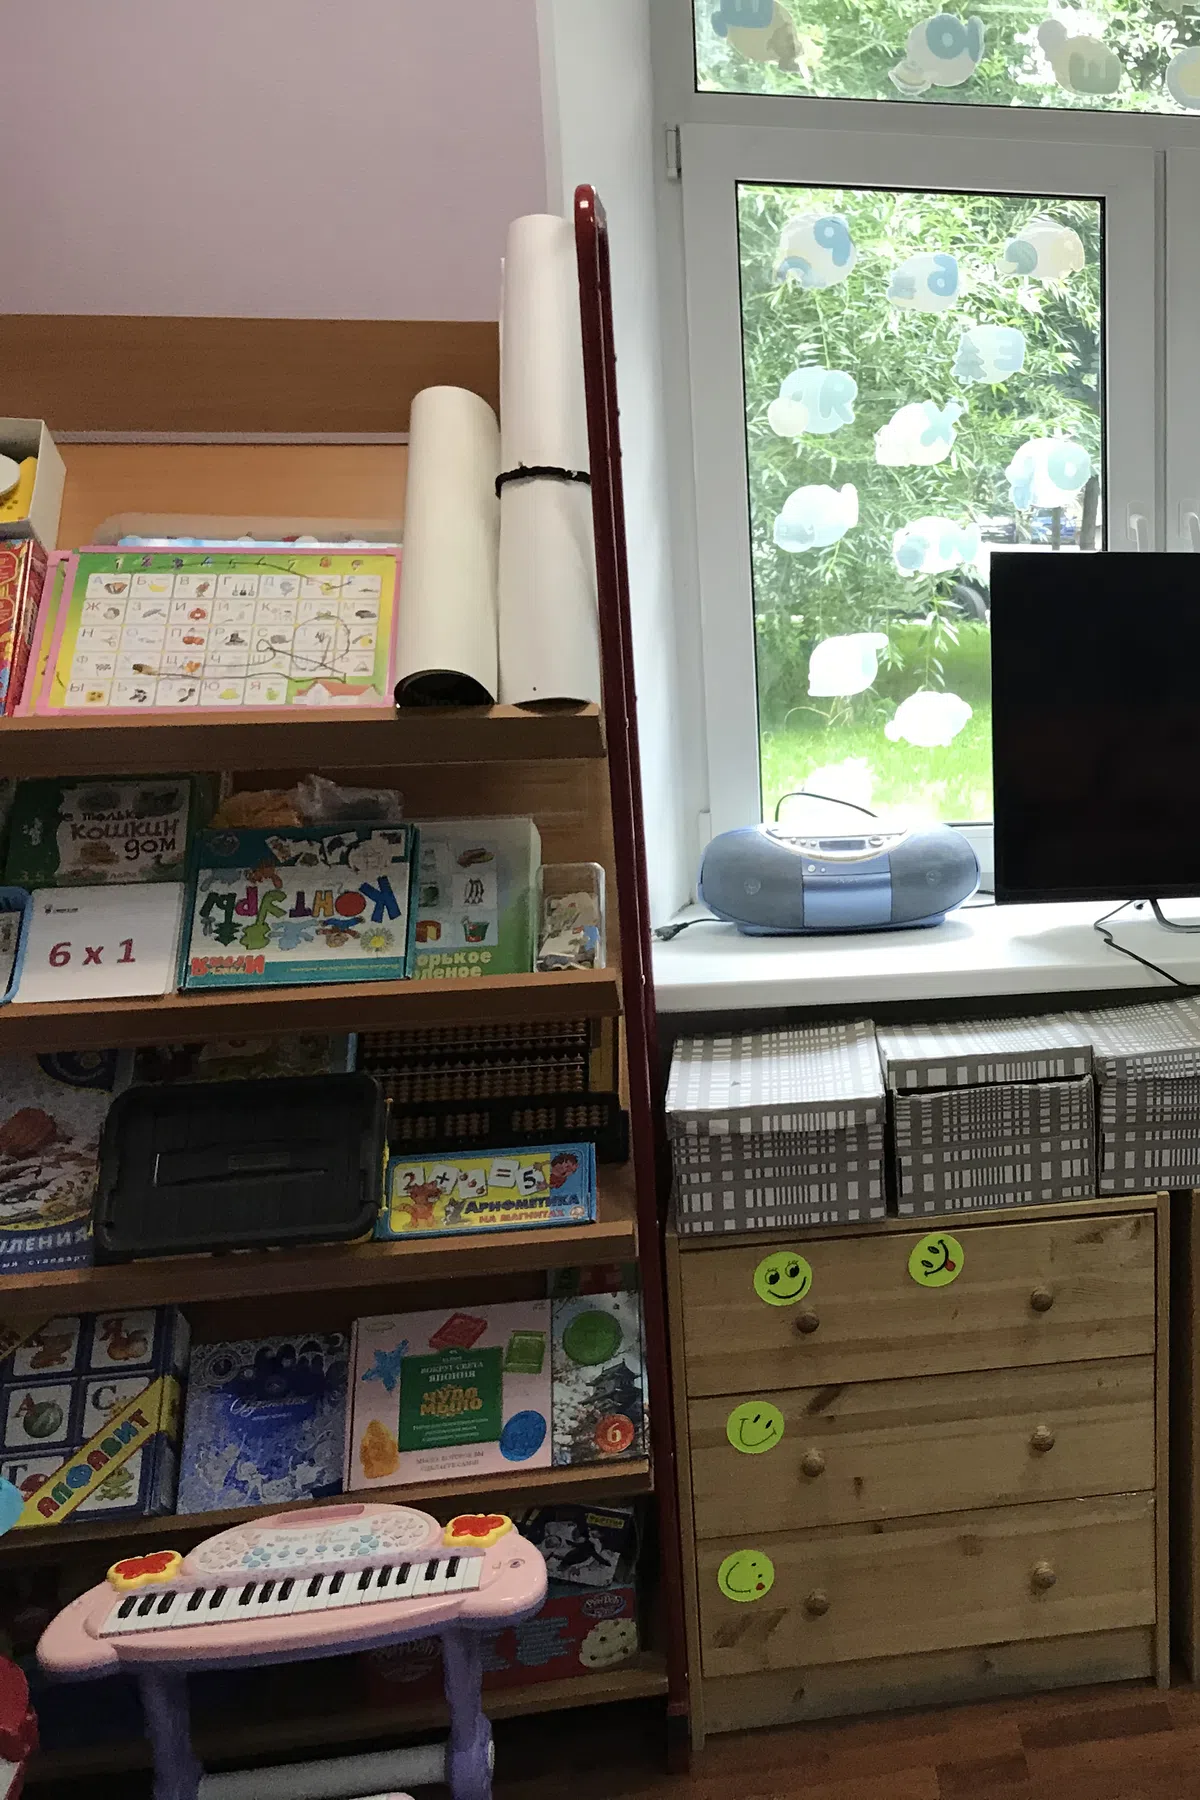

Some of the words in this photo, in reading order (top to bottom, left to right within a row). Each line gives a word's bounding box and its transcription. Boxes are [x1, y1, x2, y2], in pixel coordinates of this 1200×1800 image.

[49, 942, 72, 967] 6
[117, 938, 136, 963] 1
[416, 951, 492, 970] орькое
[415, 966, 482, 981] леное
[523, 1170, 536, 1189] 5
[606, 1416, 622, 1443] 6
[37, 1408, 149, 1518] АЛФАВИТ
